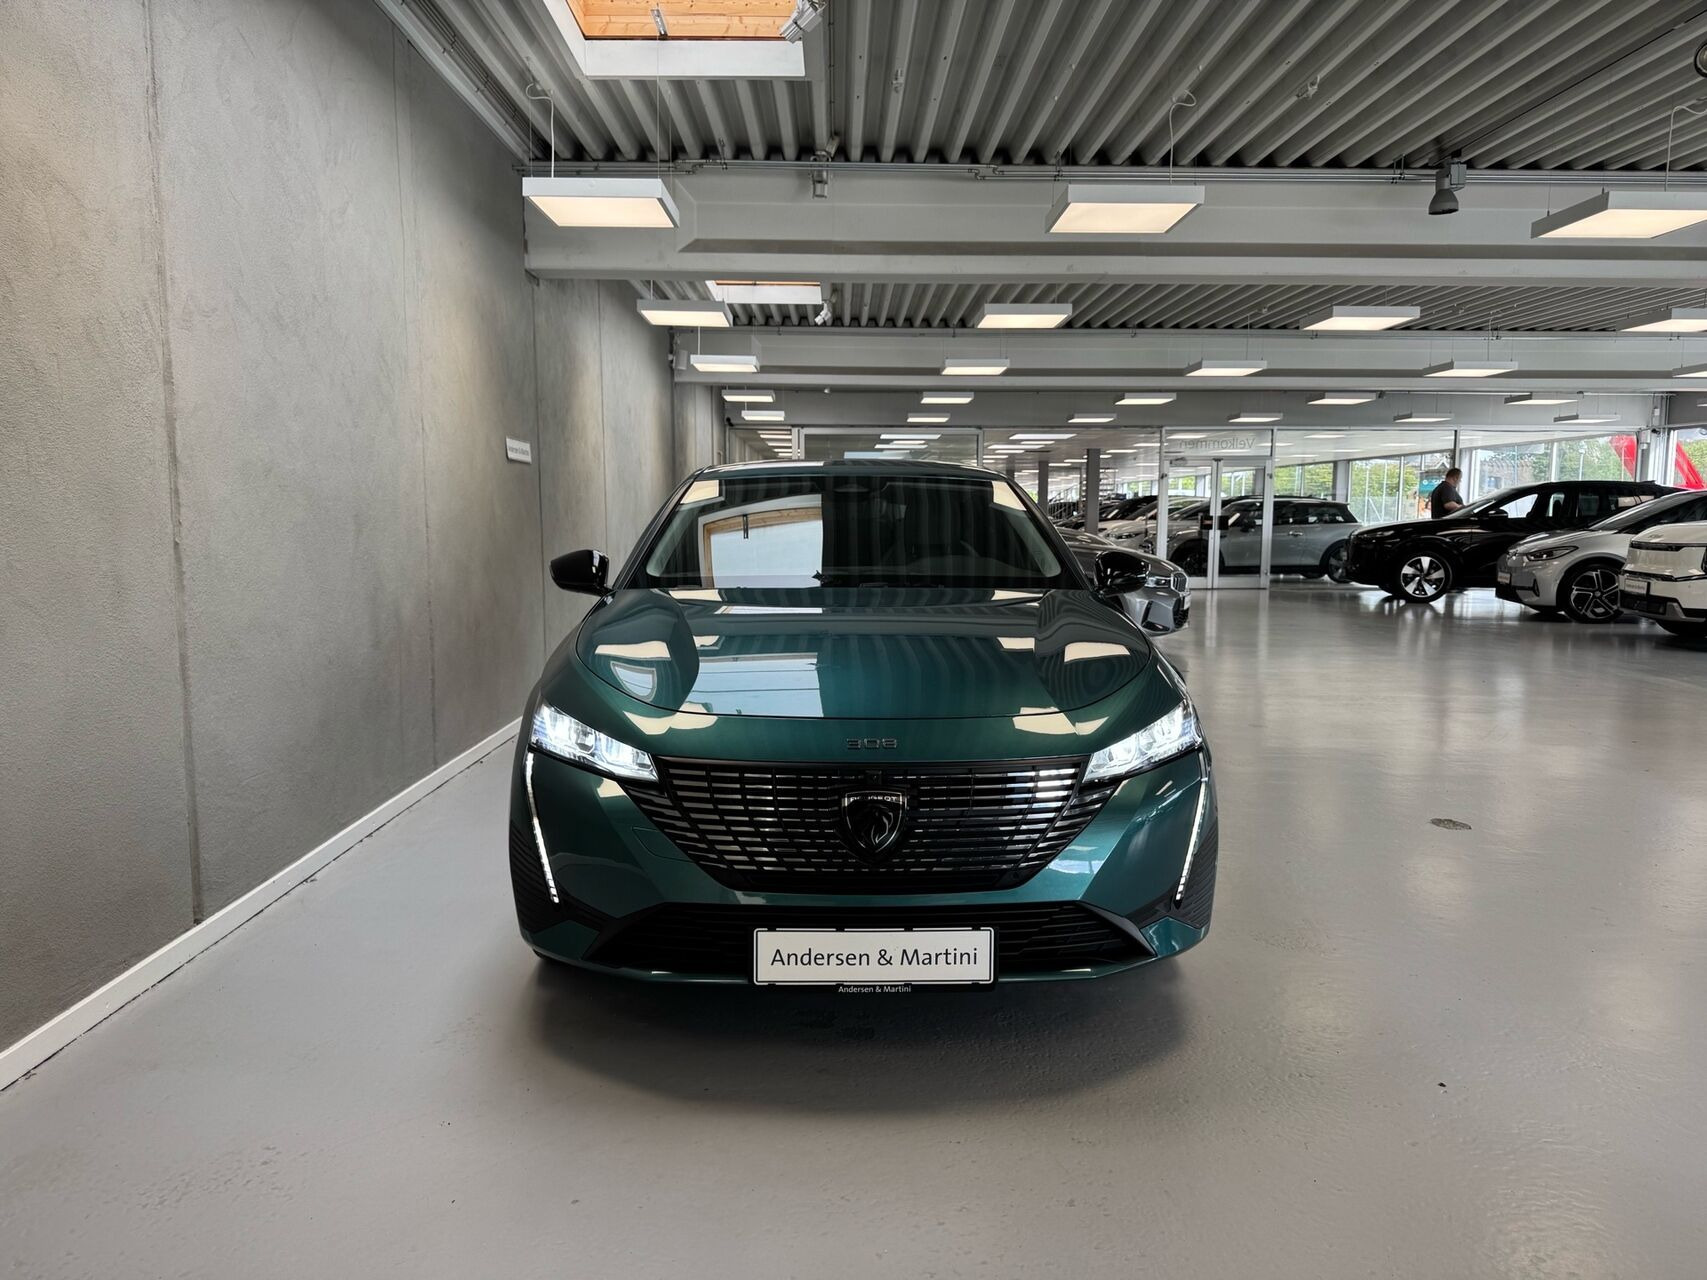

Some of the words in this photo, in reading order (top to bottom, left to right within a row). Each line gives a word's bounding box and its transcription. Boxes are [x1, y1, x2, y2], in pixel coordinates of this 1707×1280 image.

[846, 738, 897, 749] 308
[770, 947, 870, 967] Andersen
[877, 948, 894, 967] &
[900, 947, 978, 966] Martini
[838, 985, 874, 994] Andersen
[883, 984, 912, 994] Martini
